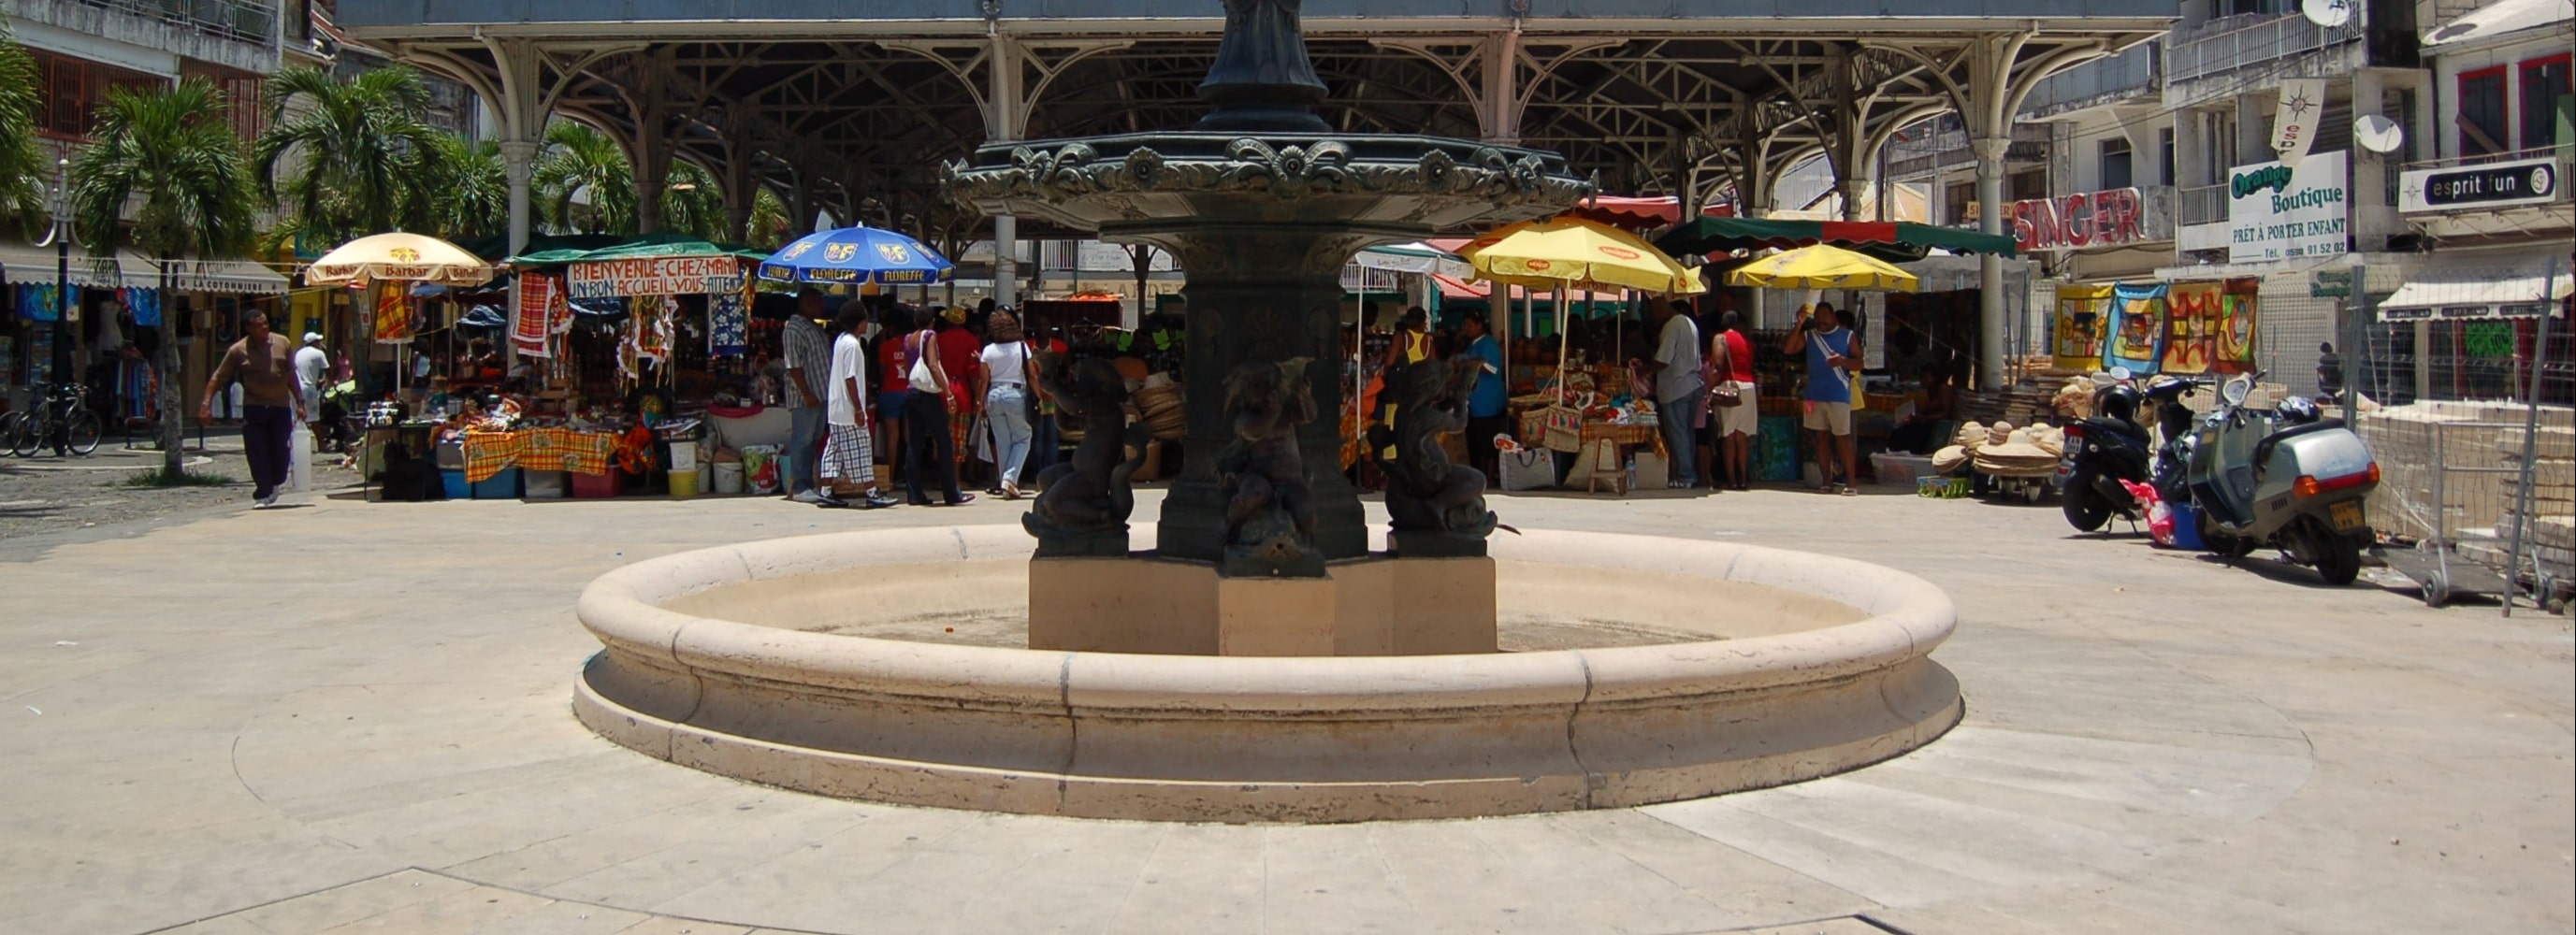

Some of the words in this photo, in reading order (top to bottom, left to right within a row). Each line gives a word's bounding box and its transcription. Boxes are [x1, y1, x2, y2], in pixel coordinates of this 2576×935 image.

[2231, 165, 2293, 199] Orange
[2433, 175, 2481, 198] esprit
[2488, 175, 2515, 192] fun
[2271, 187, 2343, 214] Boutique
[2012, 188, 2145, 251] SINGER
[2234, 224, 2255, 243] PRÊT
[2267, 223, 2304, 240] PORTER
[2308, 218, 2346, 237] ENFANT
[2308, 245, 2317, 254] 91
[2321, 243, 2331, 253] 52
[2334, 242, 2345, 252] 02
[385, 263, 429, 277] Barbar
[573, 258, 660, 280] BIENVENUE
[666, 259, 702, 277] CHEZ
[589, 280, 615, 296] BON
[617, 279, 673, 295] ACCUEIL
[674, 277, 706, 294] VOUS
